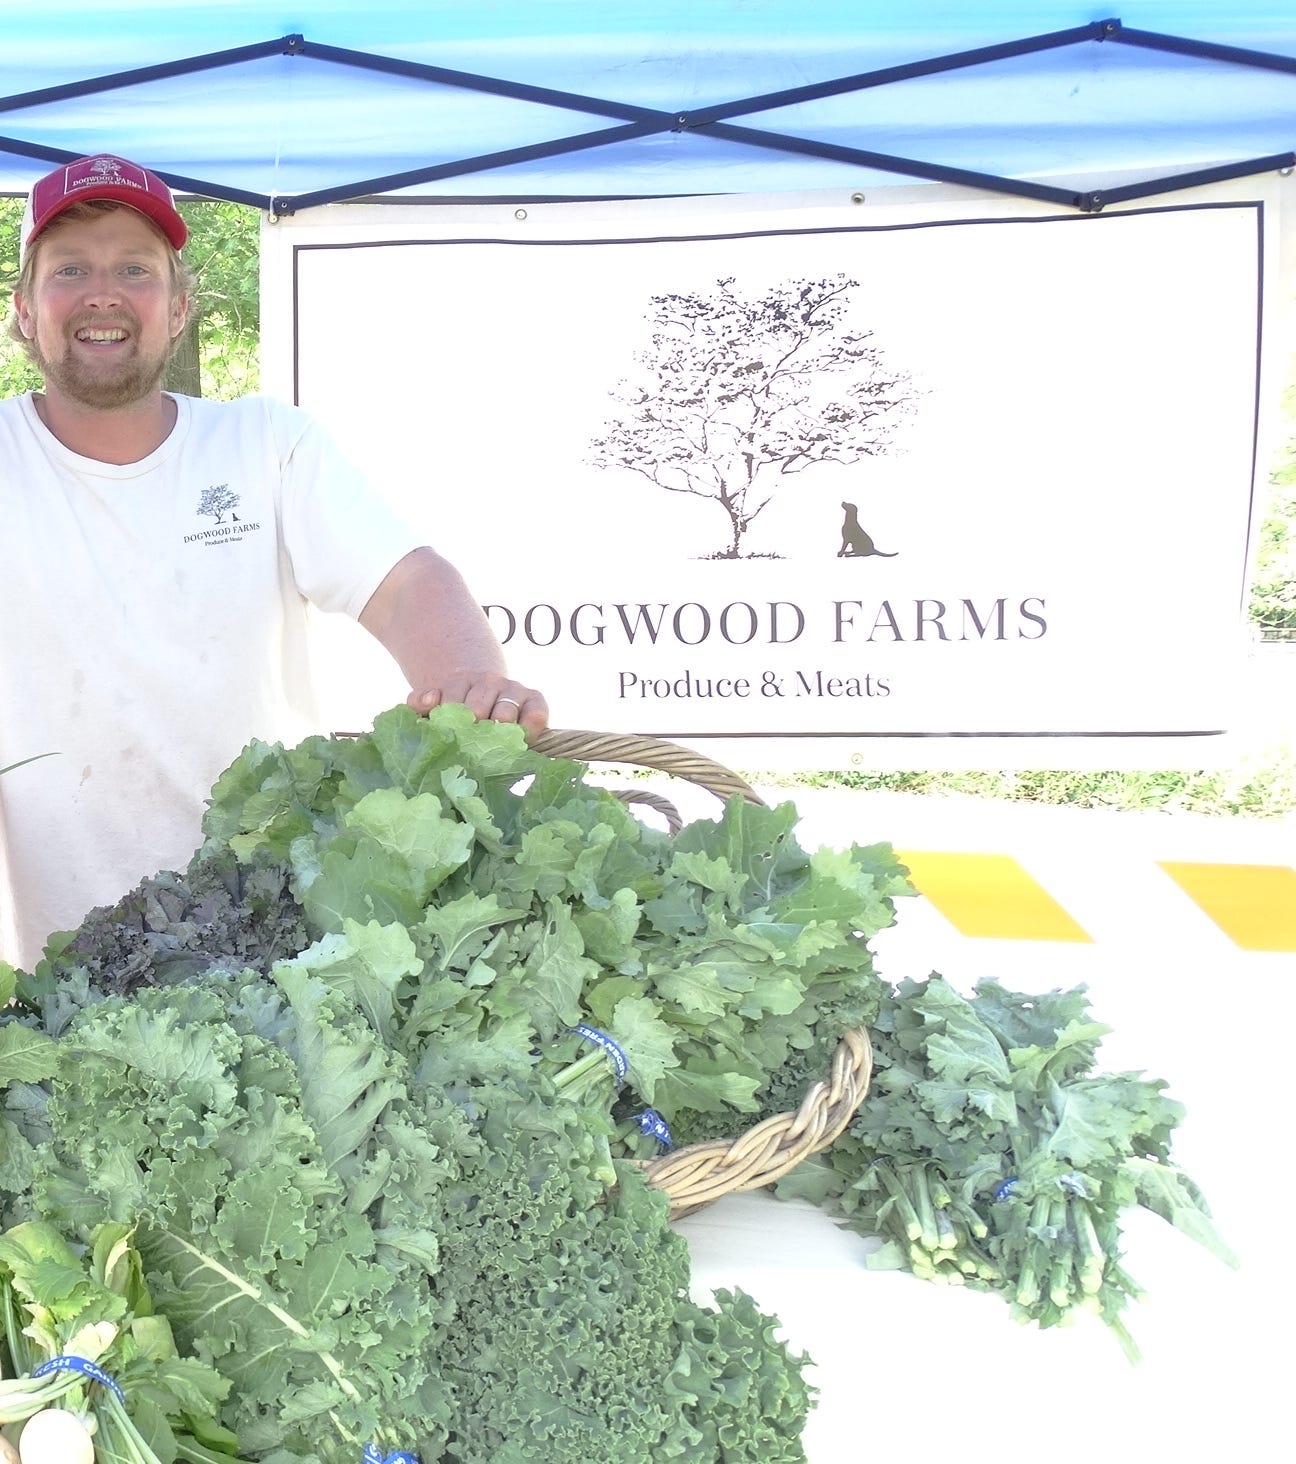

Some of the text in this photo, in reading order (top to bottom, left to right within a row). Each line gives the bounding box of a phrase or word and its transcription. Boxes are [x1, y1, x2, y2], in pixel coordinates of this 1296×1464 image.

[183, 522, 261, 544] DOGWOOD FARMS
[481, 598, 1048, 647] DOGWOOD FARMS
[618, 670, 890, 698] Produce & Meats
